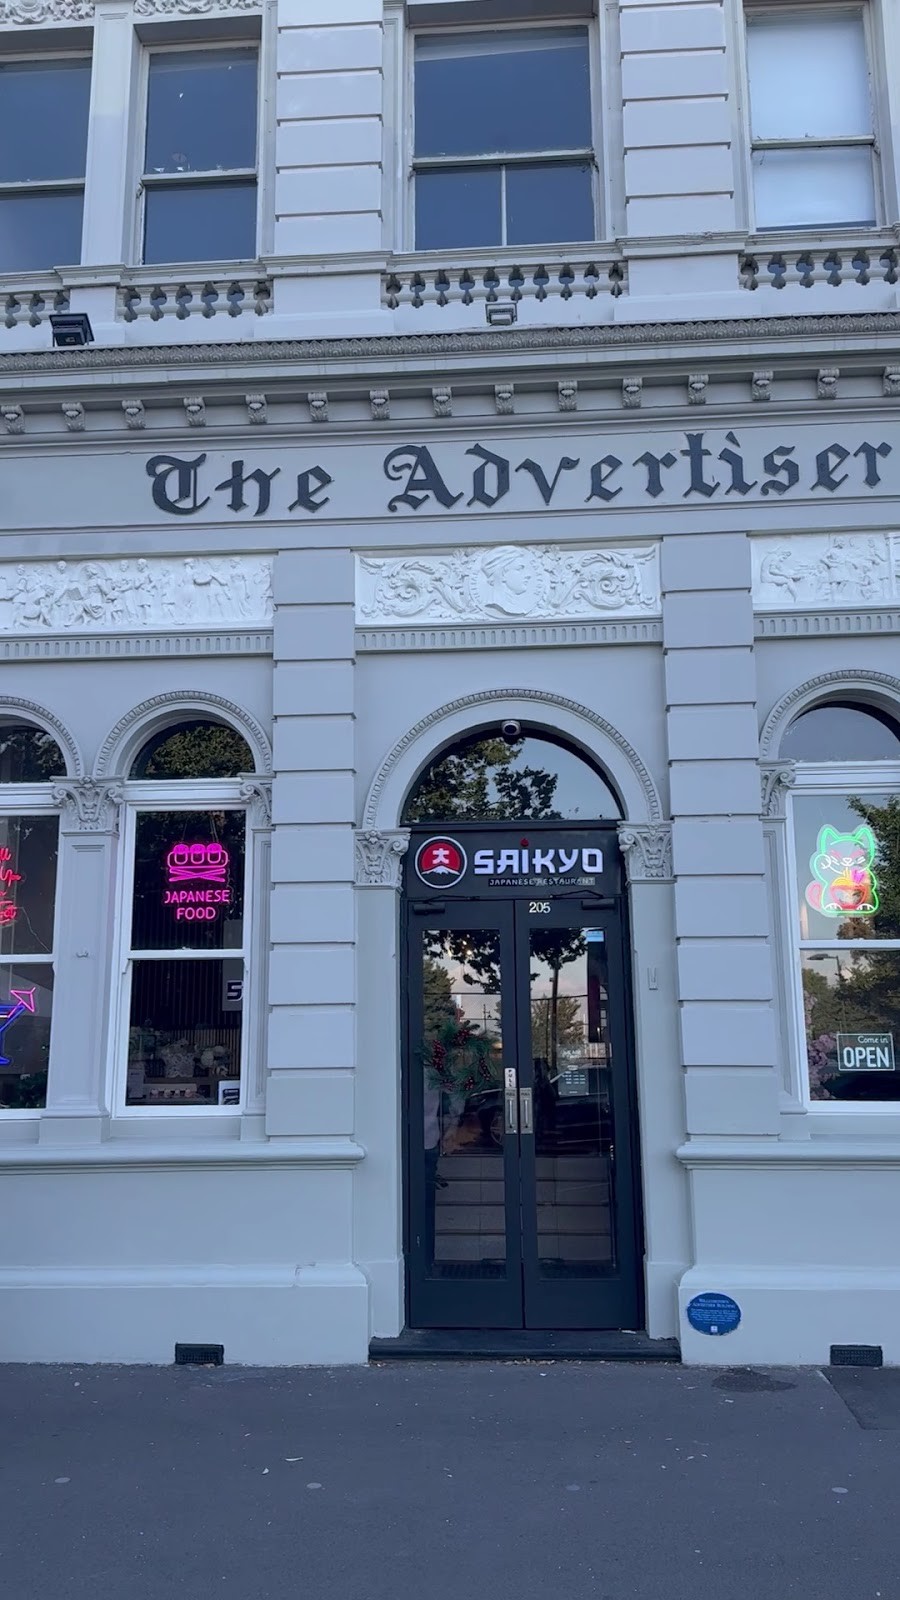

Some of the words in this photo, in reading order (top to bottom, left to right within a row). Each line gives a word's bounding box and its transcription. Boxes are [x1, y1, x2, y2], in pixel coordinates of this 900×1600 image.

[146, 453, 335, 517] The
[383, 431, 893, 513] Advertiser
[489, 878, 533, 887] JAPANESE
[535, 877, 595, 886] RESTAURANT
[163, 889, 232, 904] JAPANESE
[176, 906, 216, 920] FOOD
[529, 902, 551, 914] 205
[843, 1046, 890, 1068] OPEN
